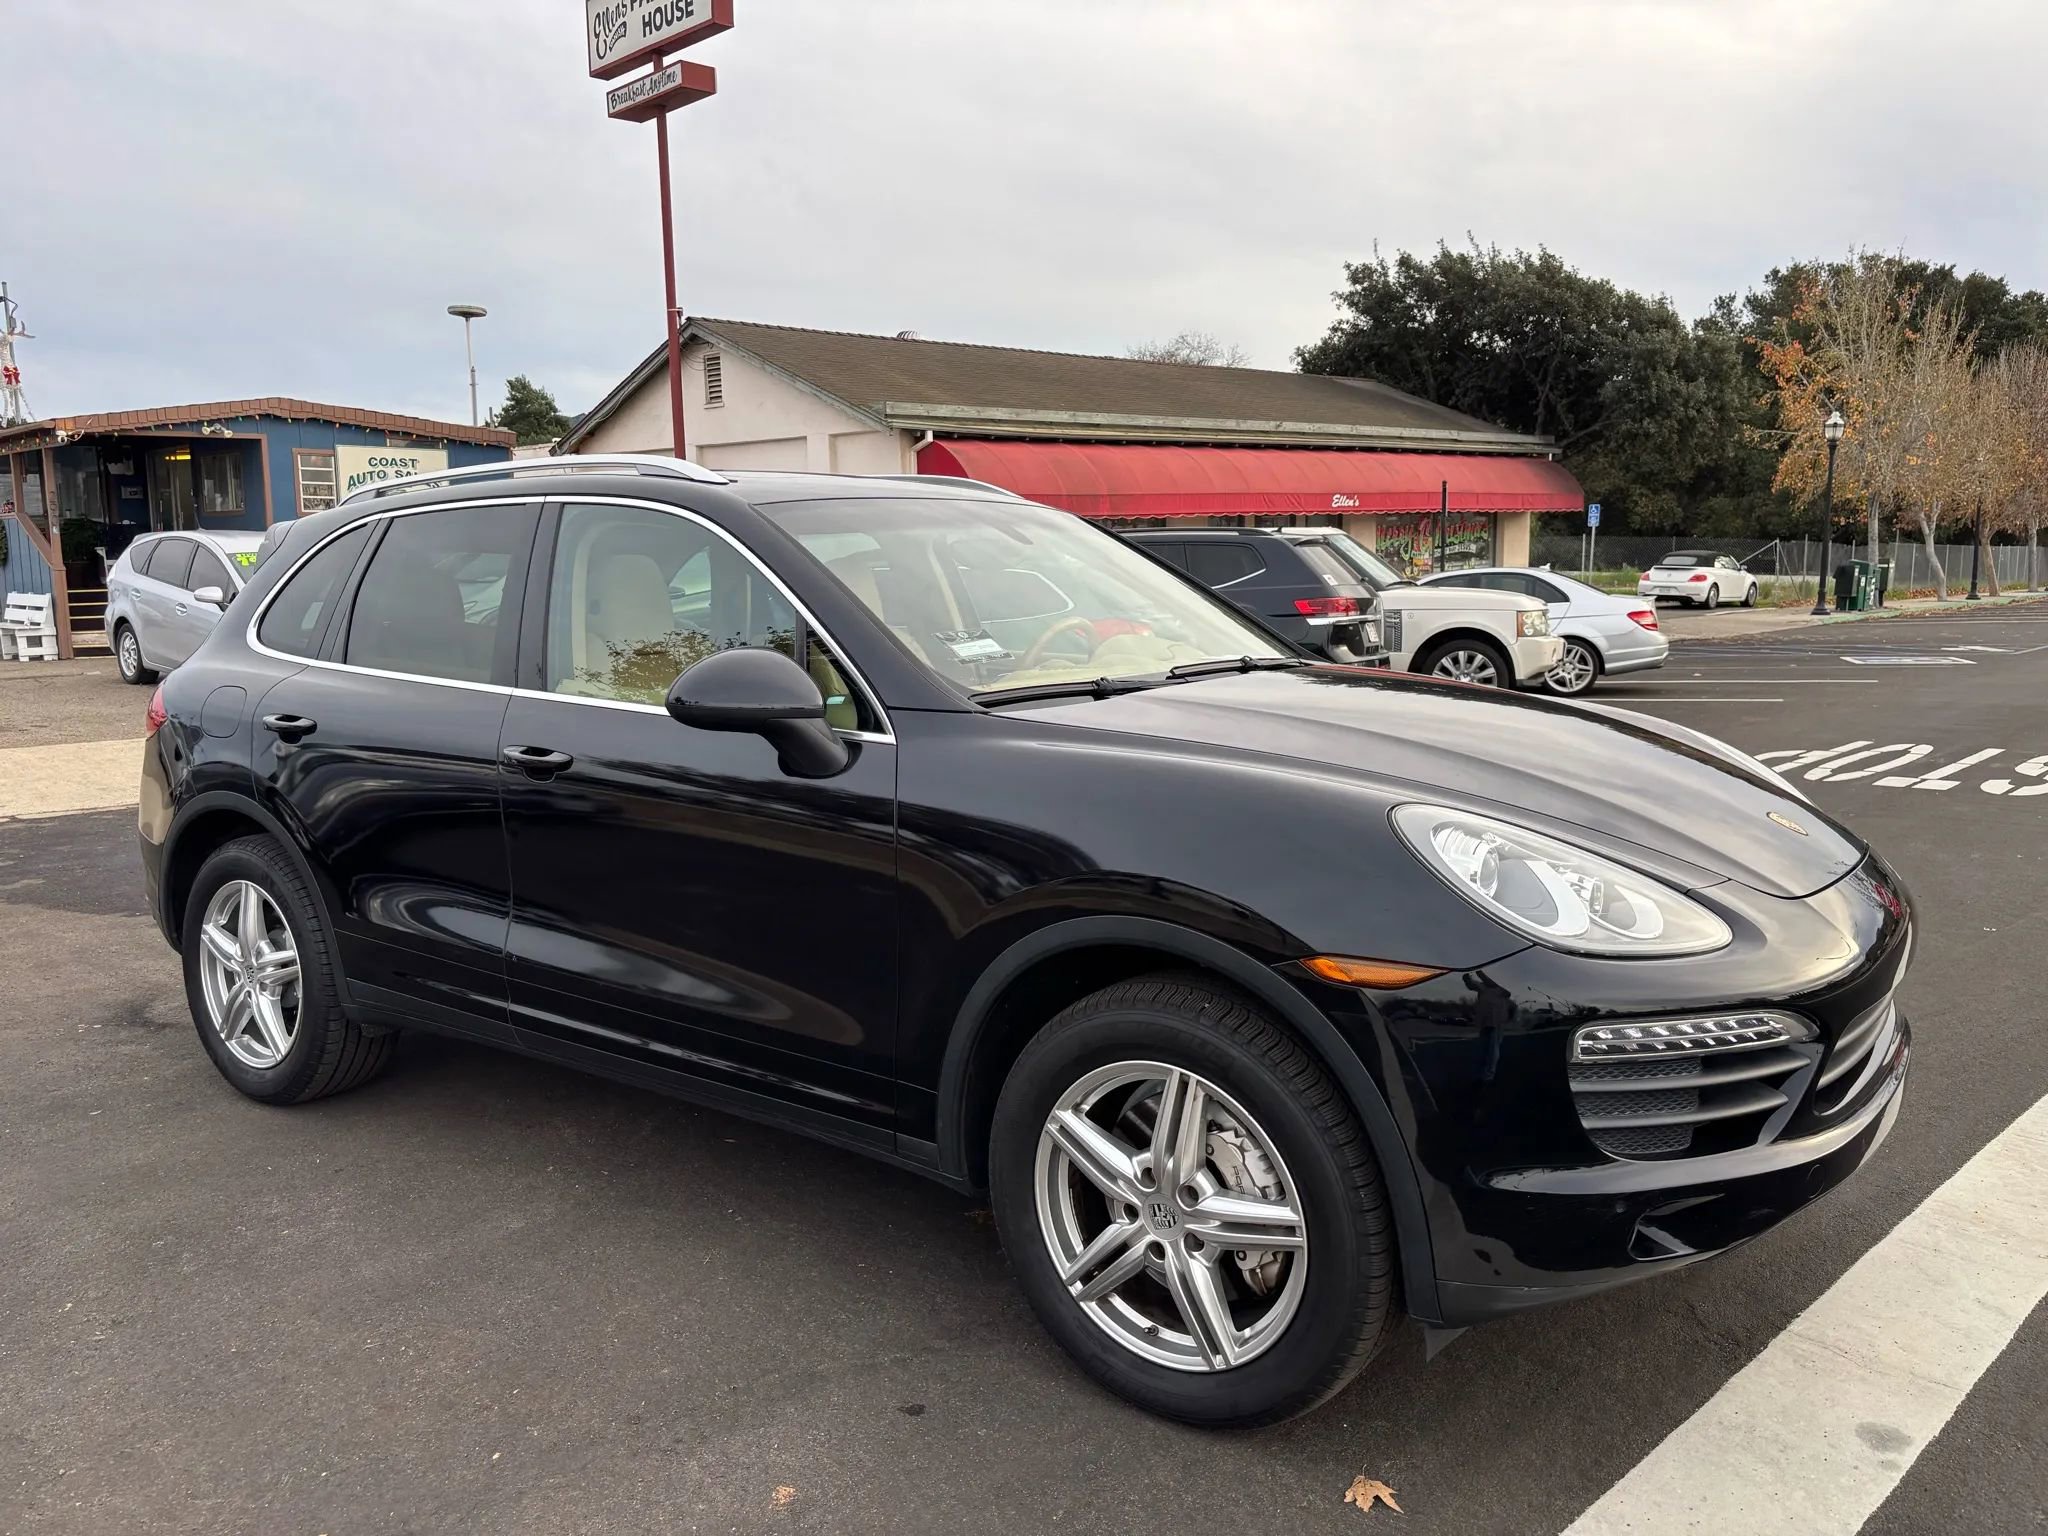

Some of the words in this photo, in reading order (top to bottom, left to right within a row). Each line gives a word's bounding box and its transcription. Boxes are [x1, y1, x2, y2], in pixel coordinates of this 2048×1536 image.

[642, 0, 695, 38] HOUSE
[610, 80, 647, 110] Breakfast
[647, 70, 678, 96] Anytime
[368, 457, 419, 469] COAST
[347, 470, 387, 491] AUTO
[1331, 494, 1360, 508] Ellen's
